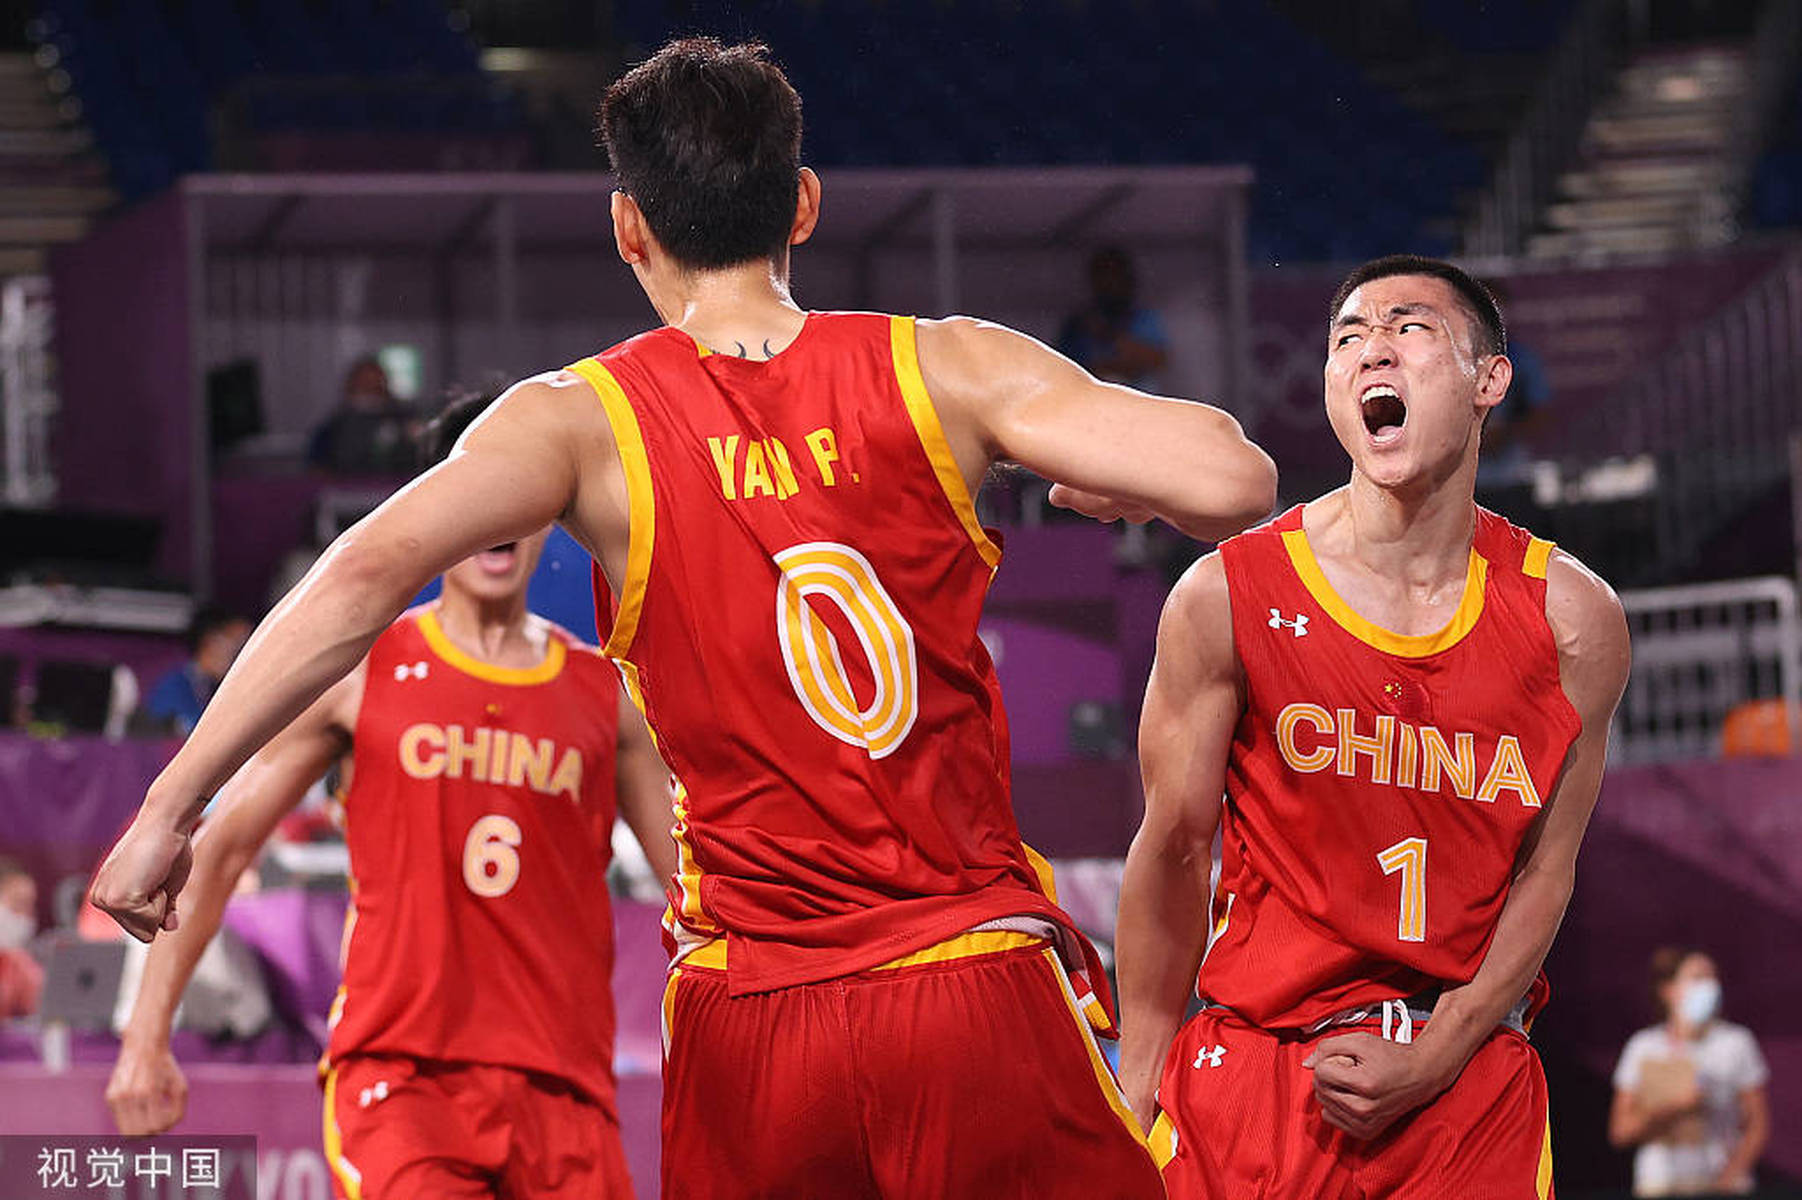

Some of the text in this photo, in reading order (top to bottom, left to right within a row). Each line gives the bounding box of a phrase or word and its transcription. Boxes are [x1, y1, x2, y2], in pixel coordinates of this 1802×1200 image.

[706, 435, 800, 500] YAN
[772, 541, 919, 760] 0
[400, 722, 583, 803] CHINA
[1275, 703, 1542, 808] CHINA
[462, 814, 522, 898] 6
[1376, 837, 1428, 942] 1
